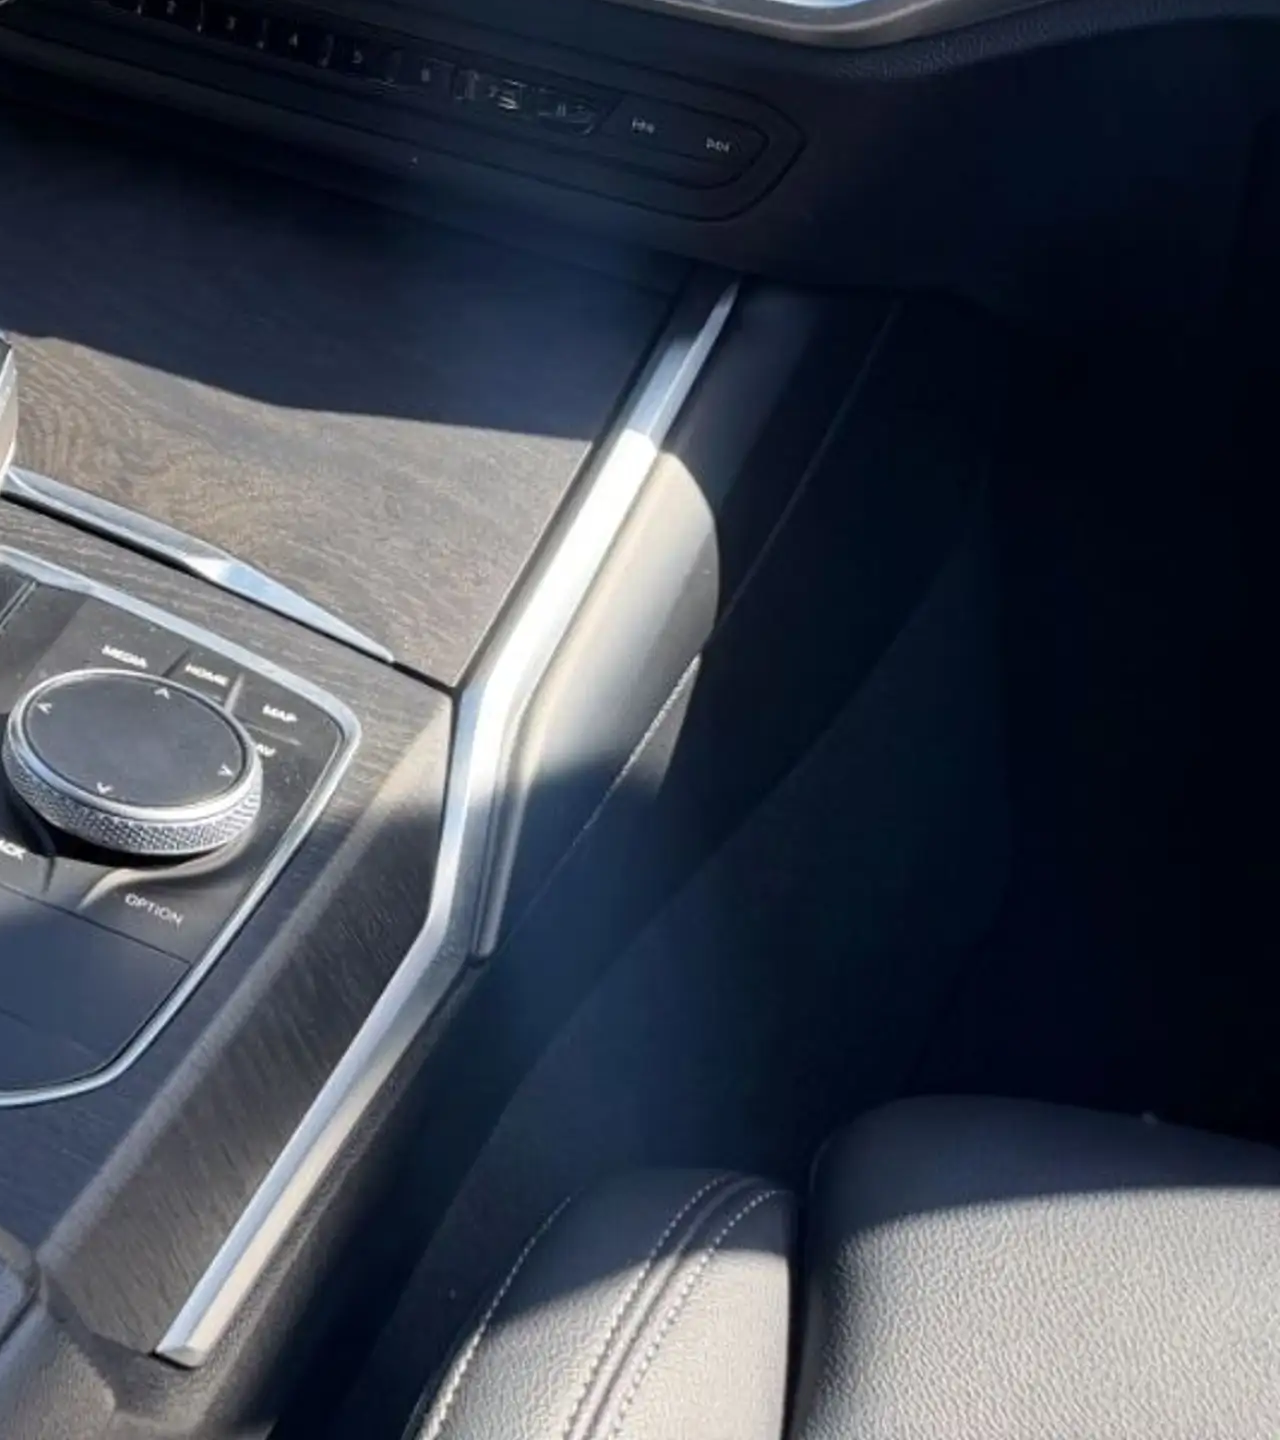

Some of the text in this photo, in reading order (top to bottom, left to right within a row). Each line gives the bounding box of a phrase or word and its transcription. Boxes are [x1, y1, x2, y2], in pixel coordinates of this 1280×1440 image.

[101, 644, 148, 669] MEDIA
[184, 662, 230, 687] HOME
[262, 703, 298, 723] MAP
[124, 891, 185, 929] OPTION
